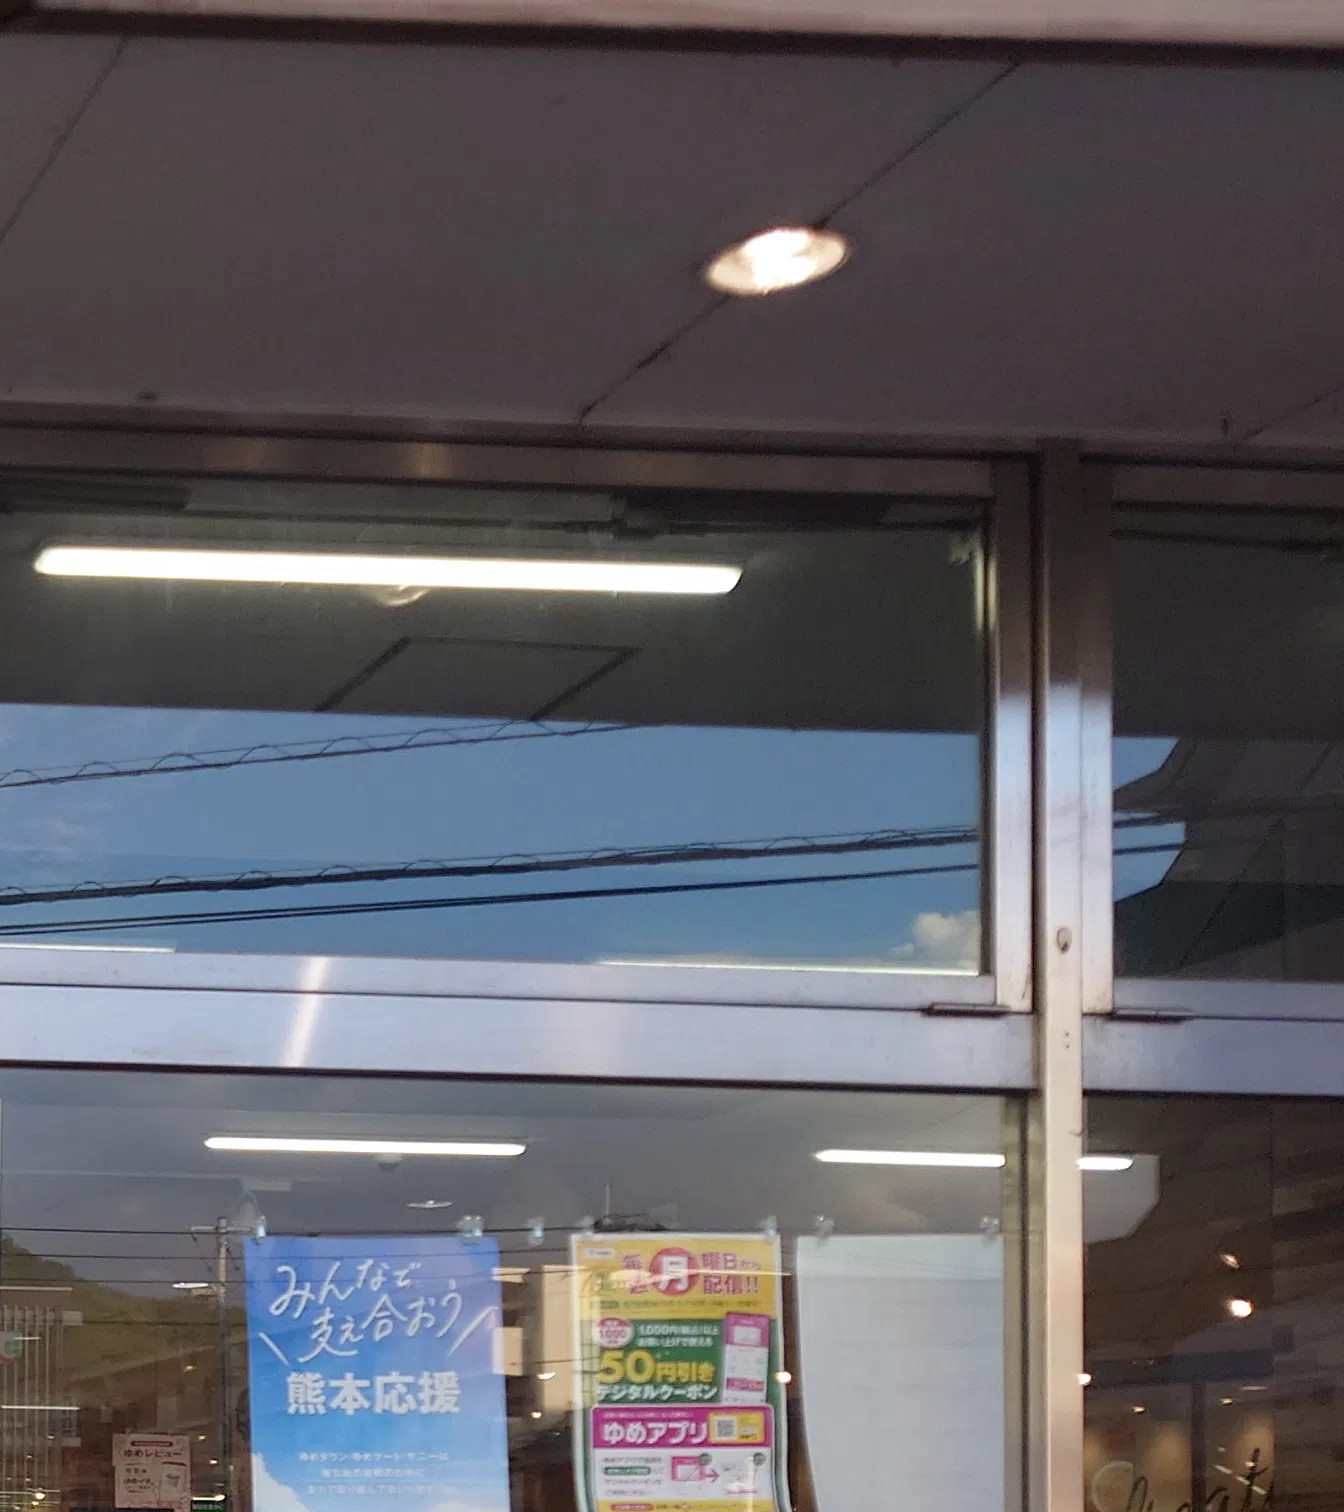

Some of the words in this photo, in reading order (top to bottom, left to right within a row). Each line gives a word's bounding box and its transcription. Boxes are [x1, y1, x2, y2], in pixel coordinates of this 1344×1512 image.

[269, 1258, 422, 1320] みんなで
[657, 1255, 690, 1291] 月
[296, 1279, 463, 1364] 支え合おう
[596, 1349, 716, 1384] 50円引き
[286, 1370, 462, 1416] 熊本応援
[596, 1383, 718, 1400] デジタルクーポン
[602, 1420, 707, 1445] ゆめアプリ
